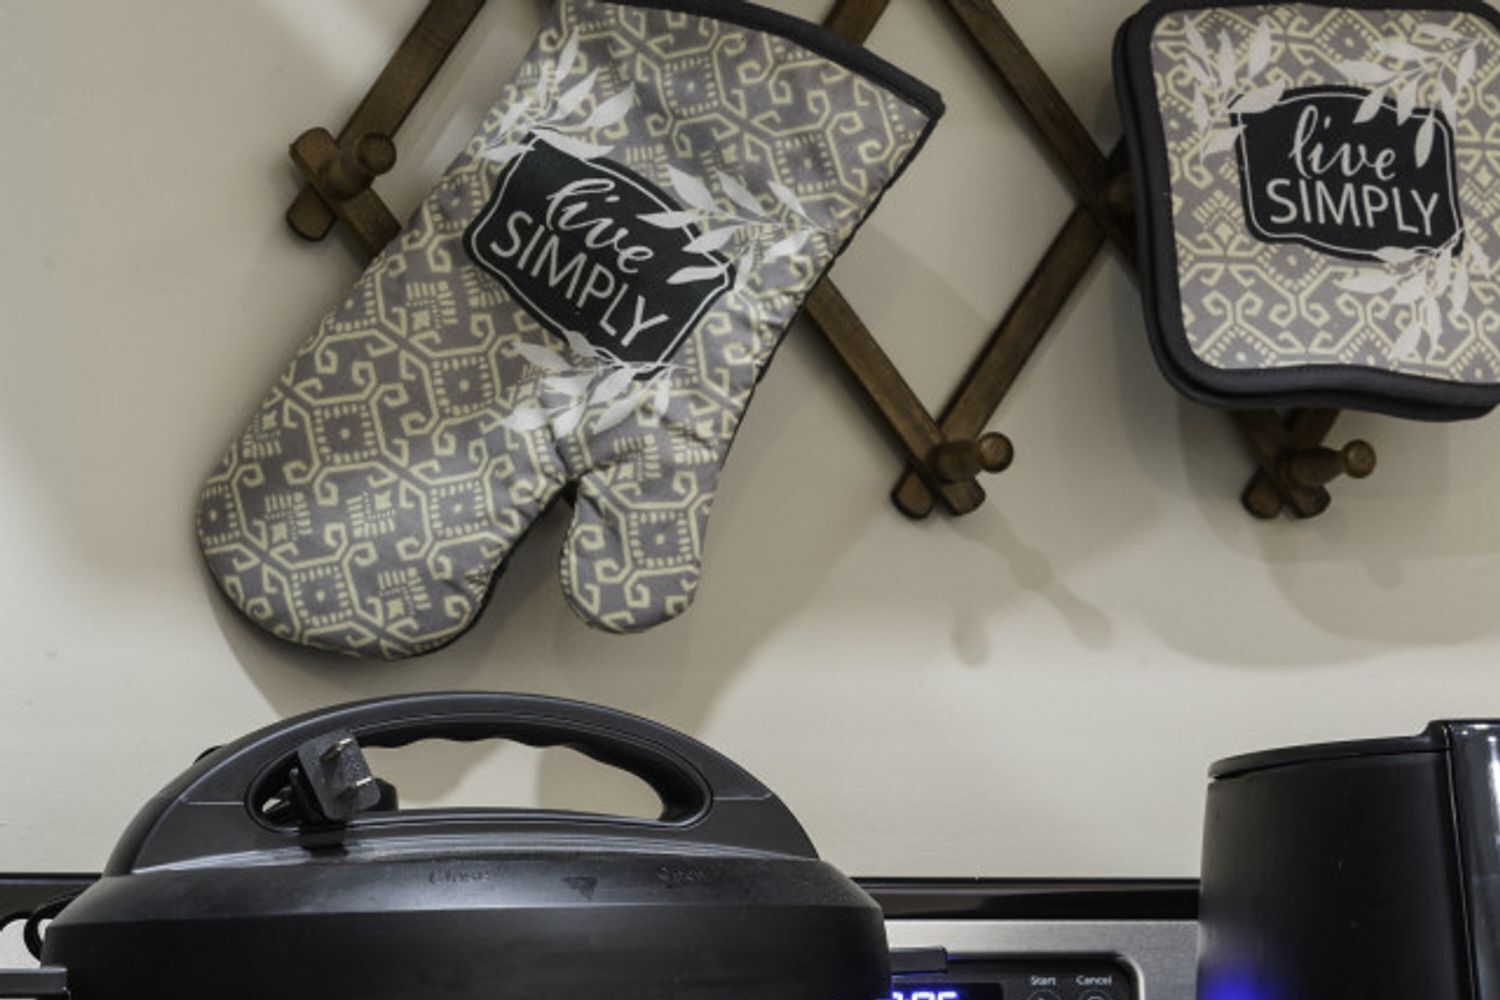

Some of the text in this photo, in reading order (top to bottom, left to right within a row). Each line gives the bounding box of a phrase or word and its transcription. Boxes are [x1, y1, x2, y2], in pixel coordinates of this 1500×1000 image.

[1288, 104, 1397, 181] live
[546, 178, 654, 274] live
[1266, 178, 1440, 236] SIMPLY
[489, 210, 670, 348] SIMPLY
